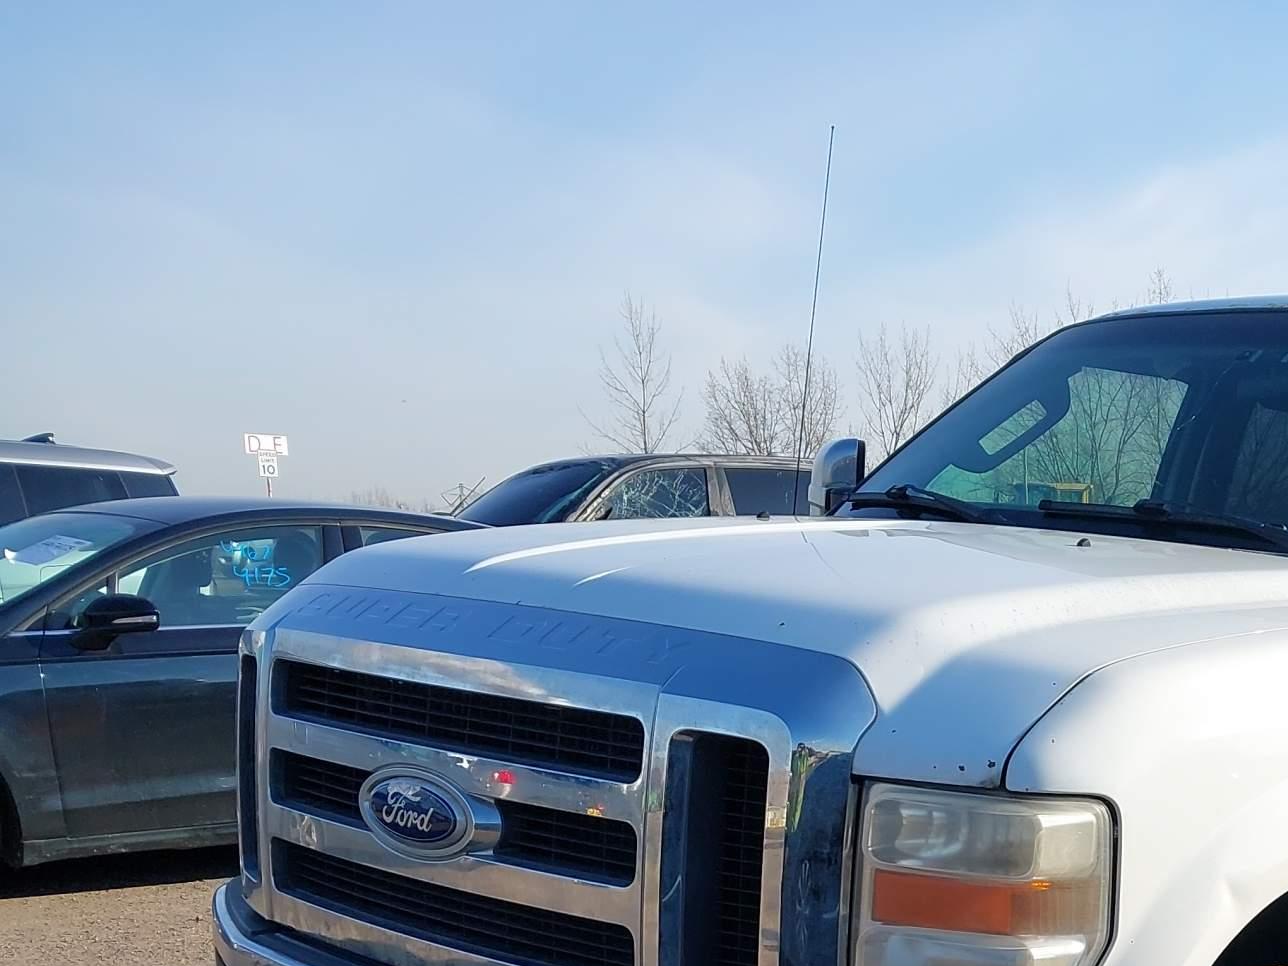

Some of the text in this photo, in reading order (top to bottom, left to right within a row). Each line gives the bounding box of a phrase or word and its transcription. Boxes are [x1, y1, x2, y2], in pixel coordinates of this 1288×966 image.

[247, 435, 283, 454] D E
[262, 464, 276, 475] 10
[233, 566, 290, 587] 4175
[296, 592, 694, 666] SUPER DUTY
[382, 782, 434, 833] Ford
